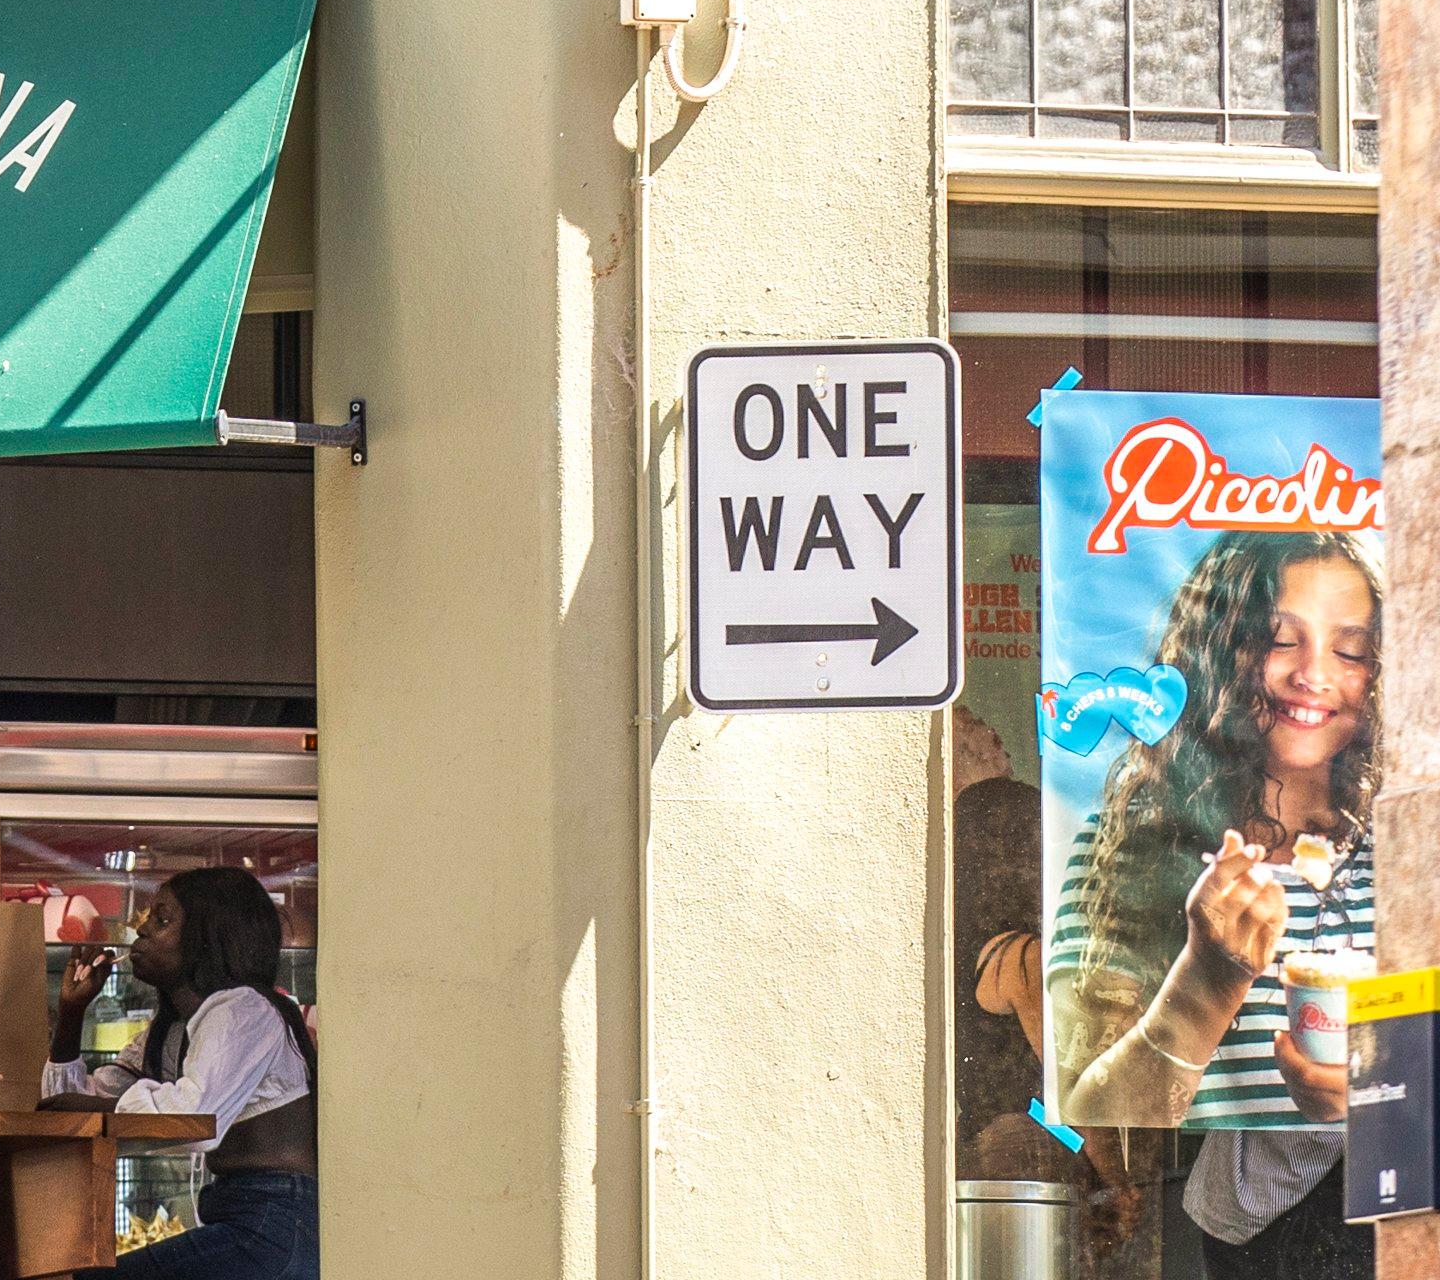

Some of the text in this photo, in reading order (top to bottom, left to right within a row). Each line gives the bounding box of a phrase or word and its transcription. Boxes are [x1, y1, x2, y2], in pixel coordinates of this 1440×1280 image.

[732, 380, 912, 463] ONE
[1093, 422, 1383, 552] Piccolin
[719, 492, 926, 575] WAY
[1065, 688, 1106, 721] CHEFS
[1117, 685, 1165, 717] WEEKS
